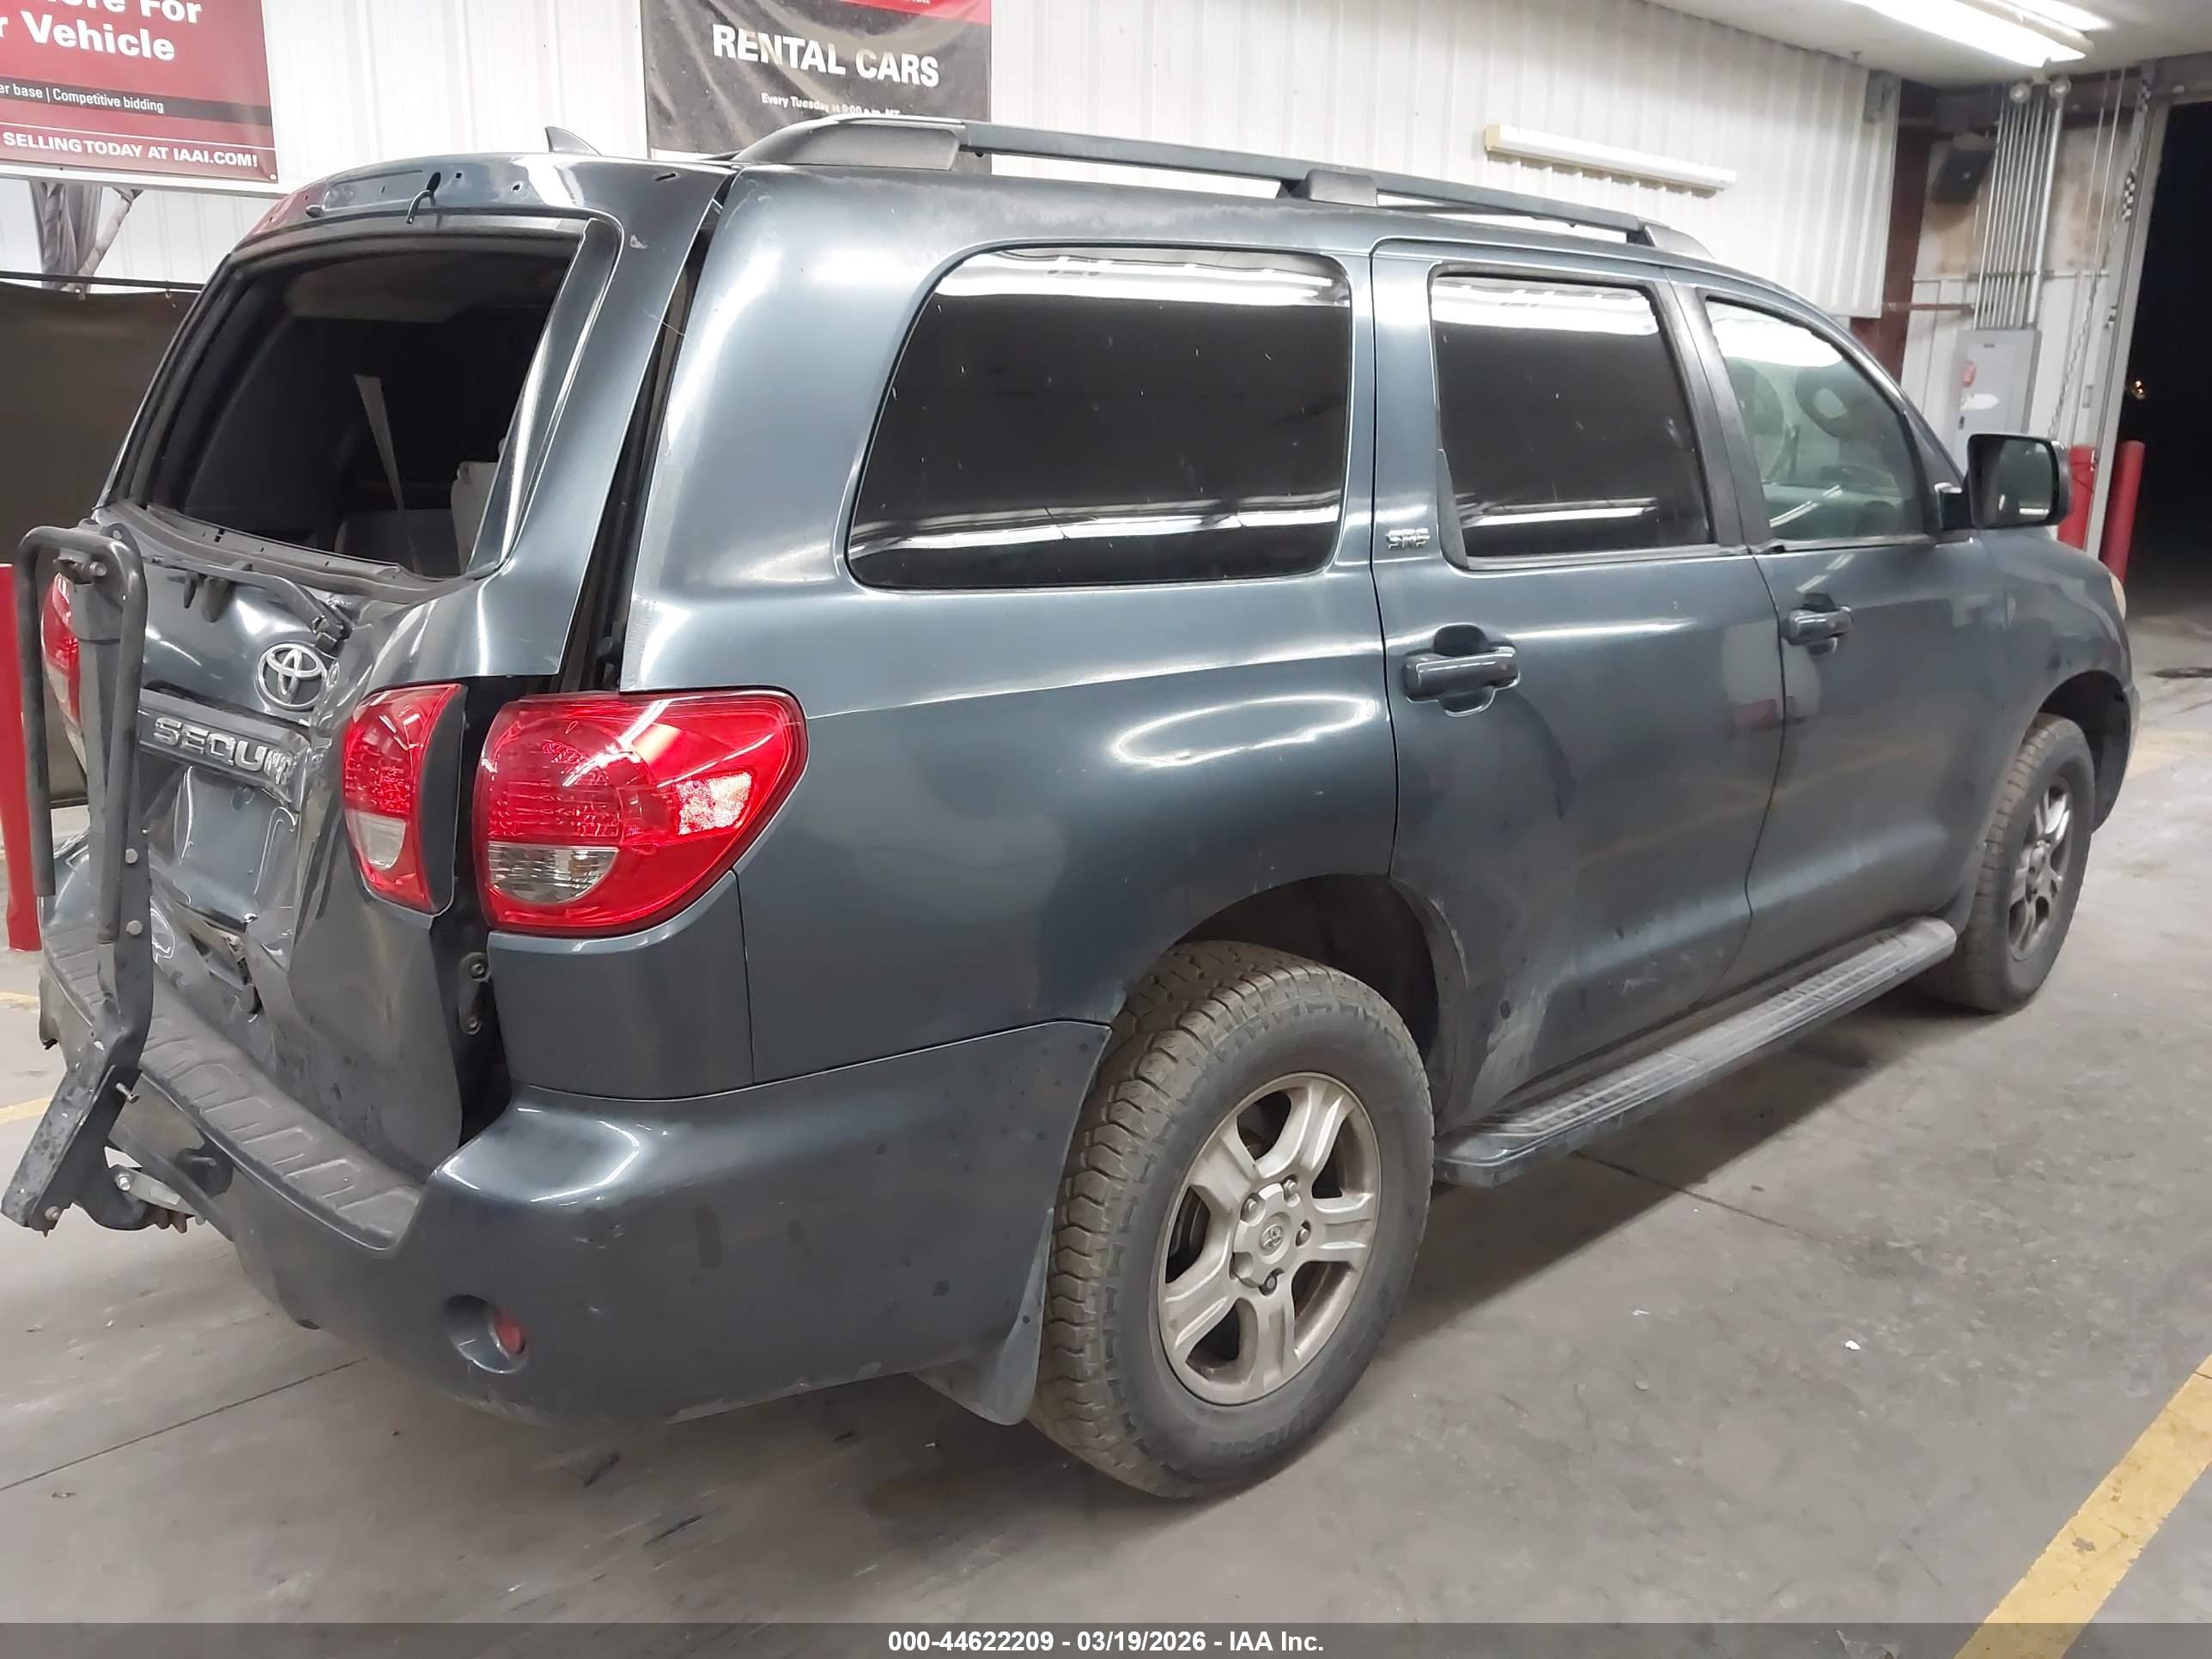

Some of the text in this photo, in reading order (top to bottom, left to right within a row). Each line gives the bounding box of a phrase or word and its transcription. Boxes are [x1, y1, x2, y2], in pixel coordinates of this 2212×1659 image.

[138, 0, 202, 23] For
[20, 10, 175, 61] Vehicle
[712, 24, 939, 87] RENTAL CARS
[13, 83, 43, 99] base
[52, 88, 121, 107] Competitive
[123, 96, 164, 113] bidding
[761, 93, 788, 108] Every
[3, 131, 258, 167] SELLING TODAY AT IAAI.COM!
